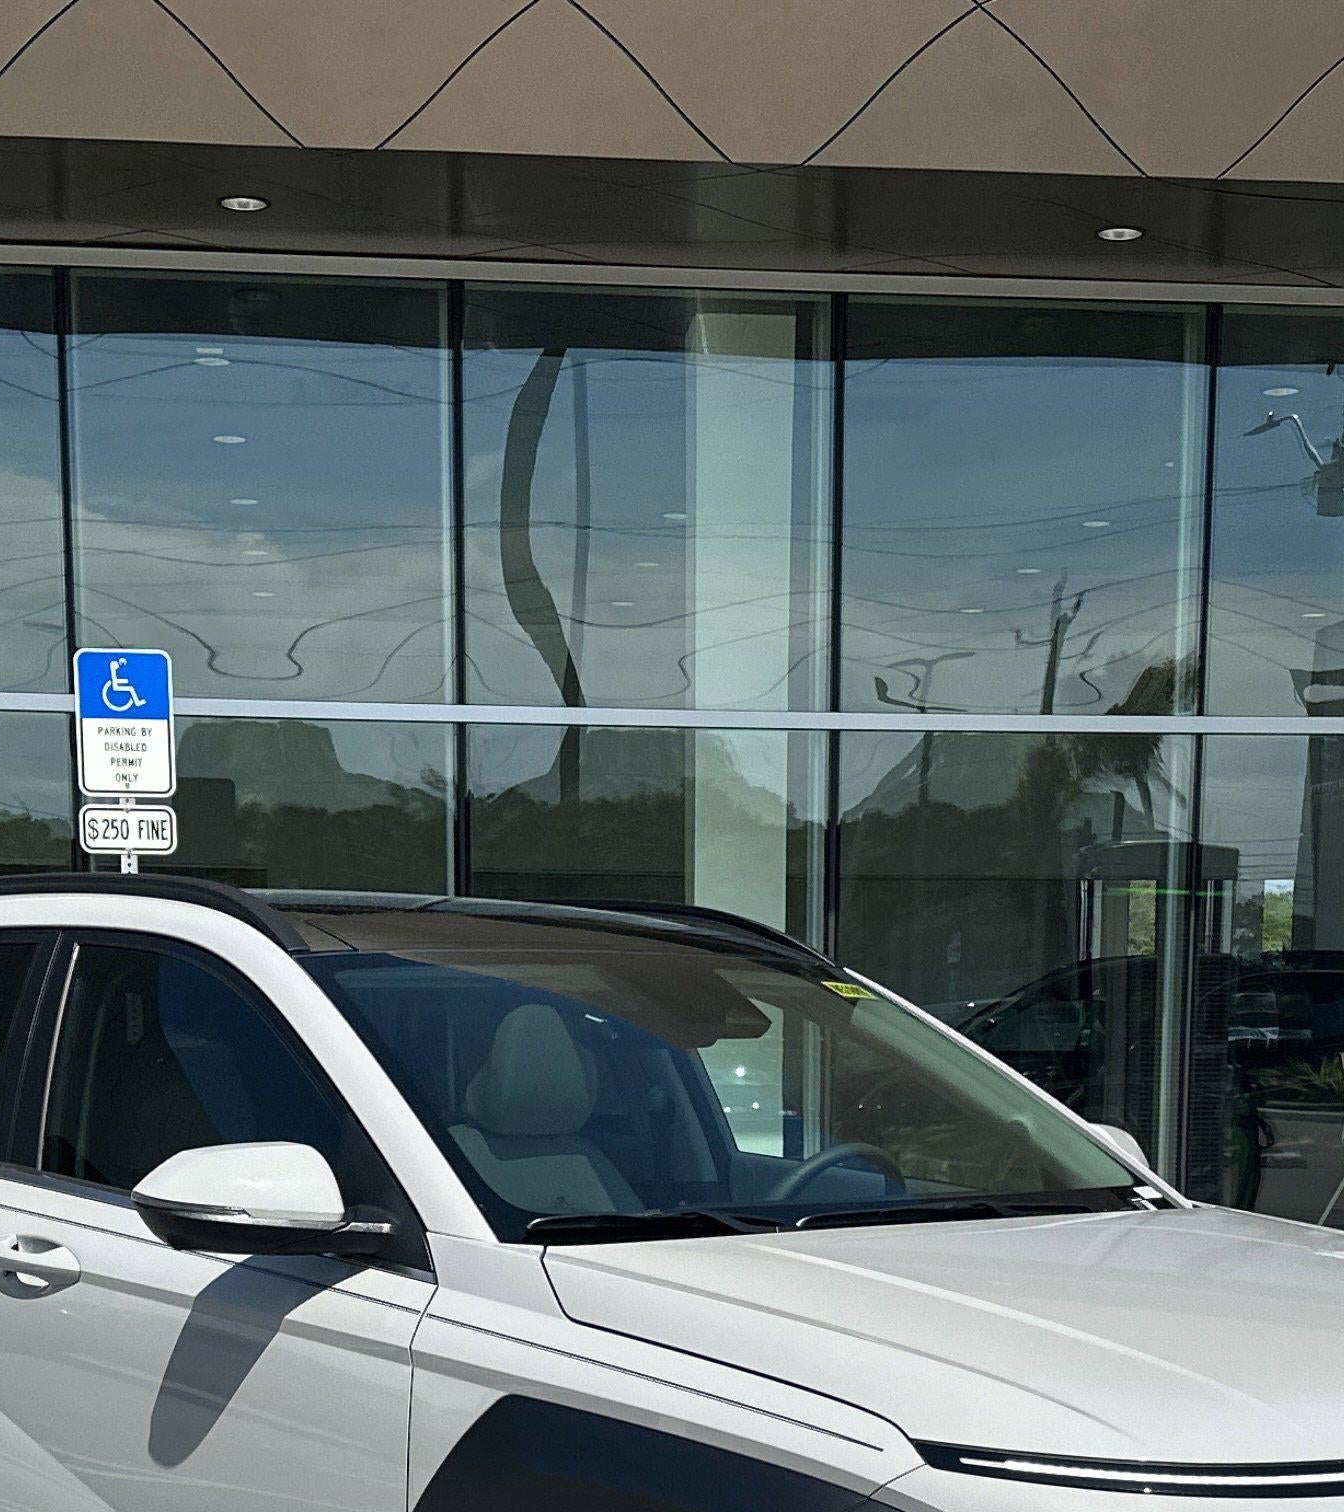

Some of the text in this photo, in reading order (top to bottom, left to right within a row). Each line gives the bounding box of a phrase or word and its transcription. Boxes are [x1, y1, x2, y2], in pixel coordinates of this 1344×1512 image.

[97, 726, 153, 737] PARKING BY
[104, 741, 148, 752] DISABLED
[110, 757, 143, 767] PERMIT
[115, 772, 139, 783] ONLY
[87, 817, 169, 842] $250 FINE
